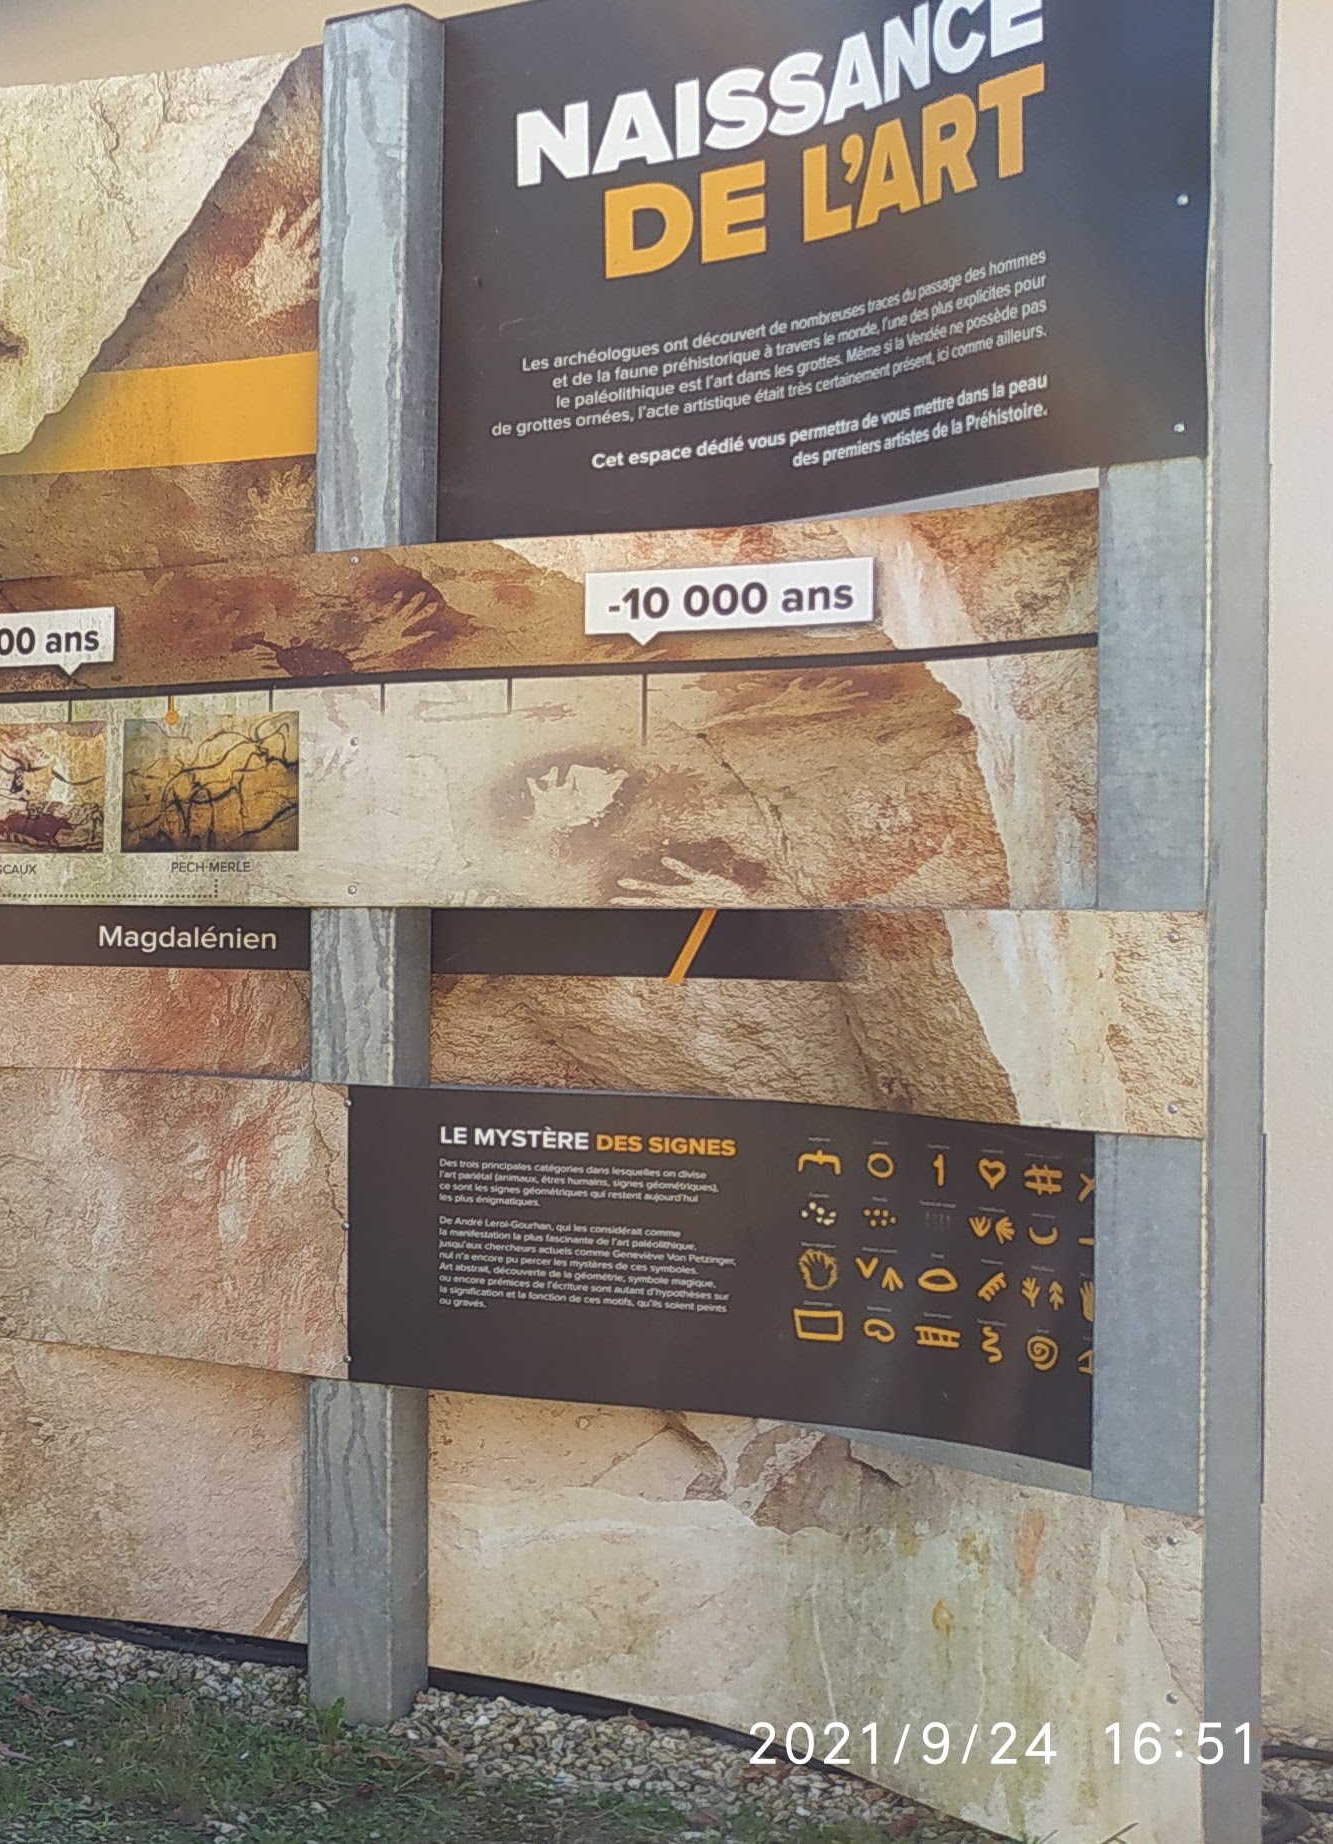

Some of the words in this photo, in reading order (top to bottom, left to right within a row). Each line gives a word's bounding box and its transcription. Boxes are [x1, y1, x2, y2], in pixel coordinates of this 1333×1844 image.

[517, 0, 1045, 187] NAISSANCE
[605, 161, 767, 280] DE
[802, 64, 1045, 244] L'ART
[522, 357, 549, 371] Les
[553, 343, 659, 368] archéologues
[663, 336, 688, 353] ont
[692, 323, 766, 348] découvert
[769, 320, 787, 335] de
[790, 304, 865, 331] nombreuses
[867, 293, 900, 313] traces
[902, 287, 916, 303] du
[918, 276, 962, 301] passage
[964, 266, 986, 283] des
[989, 250, 1046, 276] hommes
[552, 373, 568, 388] et
[572, 371, 592, 386] de
[597, 368, 610, 382] la
[614, 364, 658, 380] faune
[662, 349, 760, 377] préhistorique
[764, 343, 772, 358] à
[776, 336, 820, 356] travers
[823, 331, 835, 346] le
[838, 321, 879, 342] monde,
[882, 314, 907, 331] l'une
[910, 307, 929, 324] des
[931, 298, 953, 320] plus
[955, 283, 1011, 310] explicites
[1014, 274, 1046, 297] pour
[556, 394, 570, 408] le
[574, 384, 674, 409] paléolithique
[679, 376, 702, 393] est
[706, 372, 733, 389] l'art
[736, 368, 771, 384] dans
[774, 364, 794, 378] les
[797, 354, 842, 377] grottes.
[846, 344, 881, 363] Même
[884, 338, 892, 354] si
[895, 336, 904, 350] la
[906, 324, 947, 346] Vendée
[949, 321, 964, 335] ne
[966, 303, 1018, 331] possède
[1021, 299, 1047, 321] pas
[491, 421, 511, 436] de
[516, 417, 571, 436] grottes
[575, 408, 634, 426] ornées,
[638, 403, 679, 419] l'acte
[683, 393, 751, 413] artistique
[754, 385, 784, 403] était
[787, 381, 812, 397] très
[815, 362, 890, 392] certainement
[892, 351, 935, 377] présent,
[937, 346, 949, 362] ici
[951, 337, 993, 358] comme
[996, 324, 1046, 347] ailleurs.
[591, 451, 624, 468] Cet
[628, 446, 692, 466] espace
[696, 435, 744, 456] dédié
[747, 433, 786, 449] vous
[789, 419, 859, 447] permettra
[861, 412, 878, 429] de
[881, 407, 911, 424] vous
[913, 396, 954, 417] mettre
[957, 387, 989, 406] dans
[992, 381, 1005, 398] la
[1008, 374, 1047, 399] peau
[792, 450, 819, 467] des
[822, 439, 881, 466] premiers
[883, 428, 929, 450] artistes
[932, 422, 948, 439] de
[951, 419, 962, 435] la
[966, 403, 1047, 431] Préhistoire.
[608, 586, 670, 621] -10
[683, 581, 768, 617] 000
[781, 583, 854, 613] ans
[45, 628, 100, 654] ans
[171, 861, 251, 875] PECH-MERLE
[98, 925, 278, 954] Magdalénien
[441, 1126, 467, 1144] LE
[474, 1126, 589, 1150] MYSTÈRE
[596, 1134, 642, 1152] DES
[649, 1136, 735, 1156] SIGNES
[439, 1158, 457, 1167] Des
[459, 1160, 479, 1168] trois
[481, 1162, 532, 1171] principales
[534, 1163, 584, 1174] catégories
[585, 1165, 610, 1175] dans
[611, 1166, 661, 1177] lesquelles
[678, 1170, 707, 1179] divise
[458, 1172, 492, 1180] pariétal
[494, 1173, 539, 1184] (animaux,
[540, 1175, 565, 1184] êtres
[567, 1176, 610, 1187] humains,
[612, 1179, 644, 1189] signes
[646, 1180, 719, 1193] géométriques),
[439, 1193, 452, 1202] les
[454, 1194, 474, 1203] plus
[475, 1194, 540, 1207] énigmatiques.
[452, 1183, 472, 1191] sont
[474, 1183, 488, 1192] les
[490, 1184, 520, 1195] signes
[522, 1186, 588, 1198] géométriques
[590, 1190, 606, 1199] qui
[607, 1191, 642, 1200] restent
